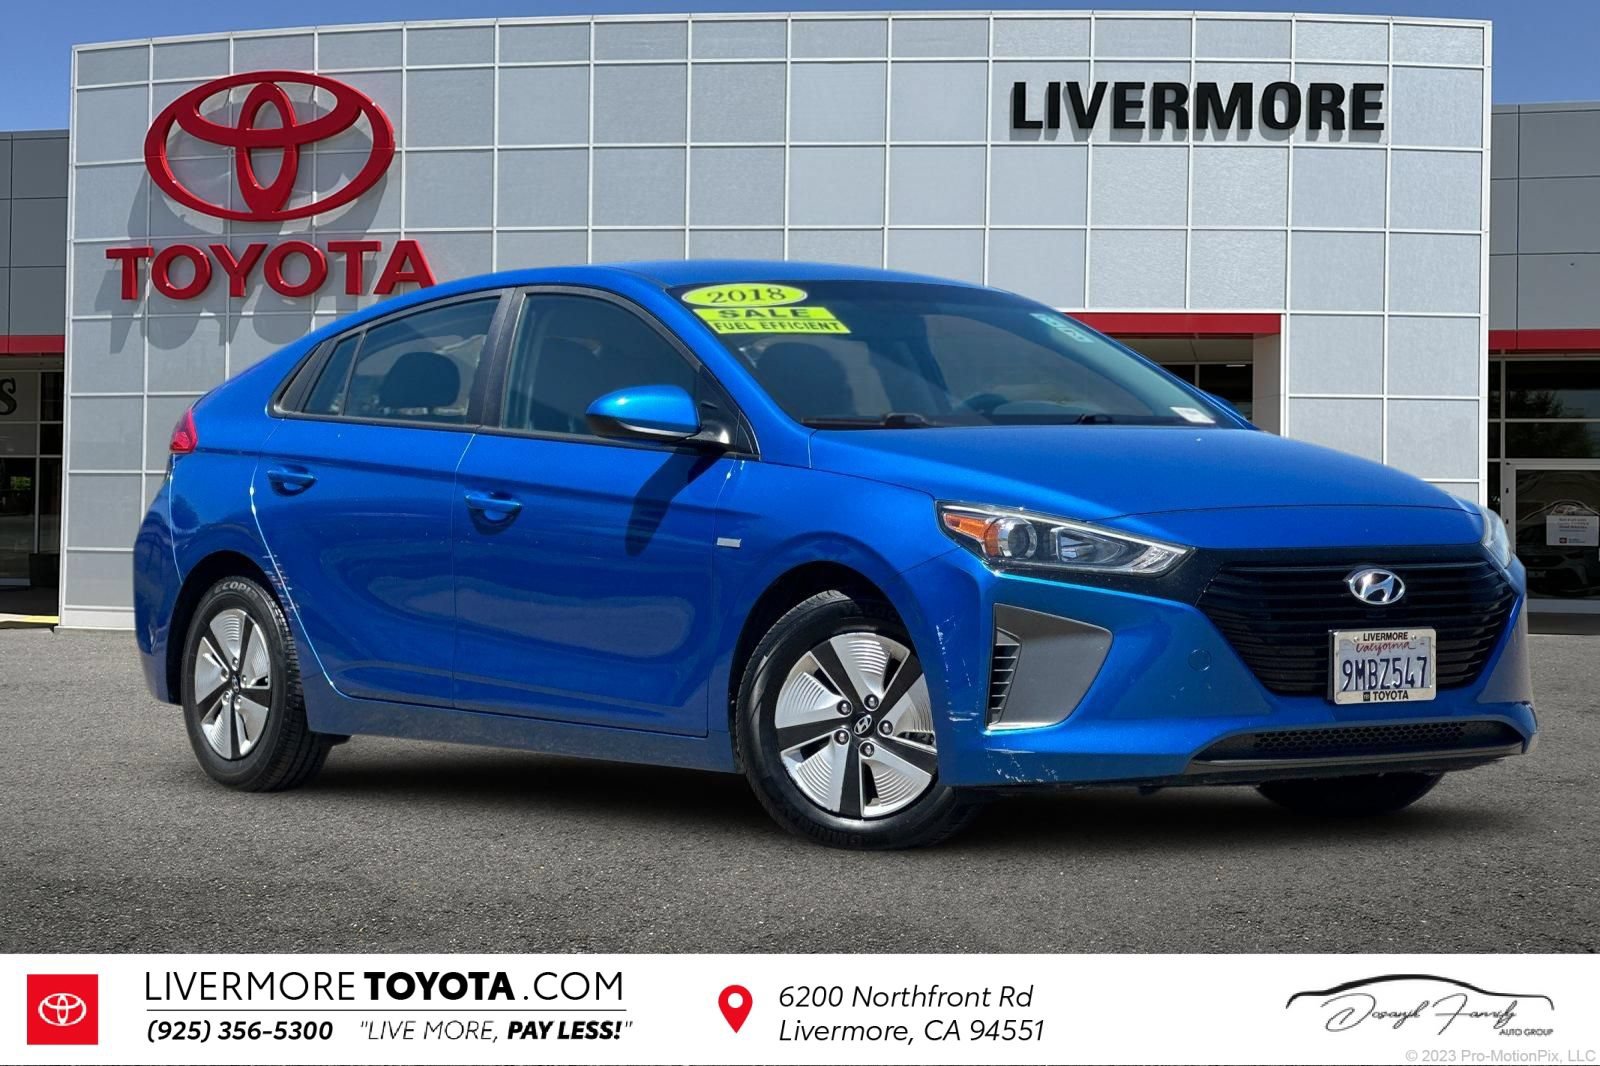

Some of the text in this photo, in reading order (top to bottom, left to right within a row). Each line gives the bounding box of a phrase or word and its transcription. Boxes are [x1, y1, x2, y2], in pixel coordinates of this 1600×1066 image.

[1012, 82, 1385, 131] LIVERMORE
[106, 240, 437, 300] TOYOTA
[707, 288, 786, 304] 2018
[718, 308, 811, 319] SALE
[714, 322, 841, 331] FUEL EFFICIENT
[1363, 631, 1408, 641] LIVERMORE
[1356, 641, 1416, 656] California
[1342, 656, 1427, 691] 9MBZ547
[1373, 690, 1408, 700] TOYOTA
